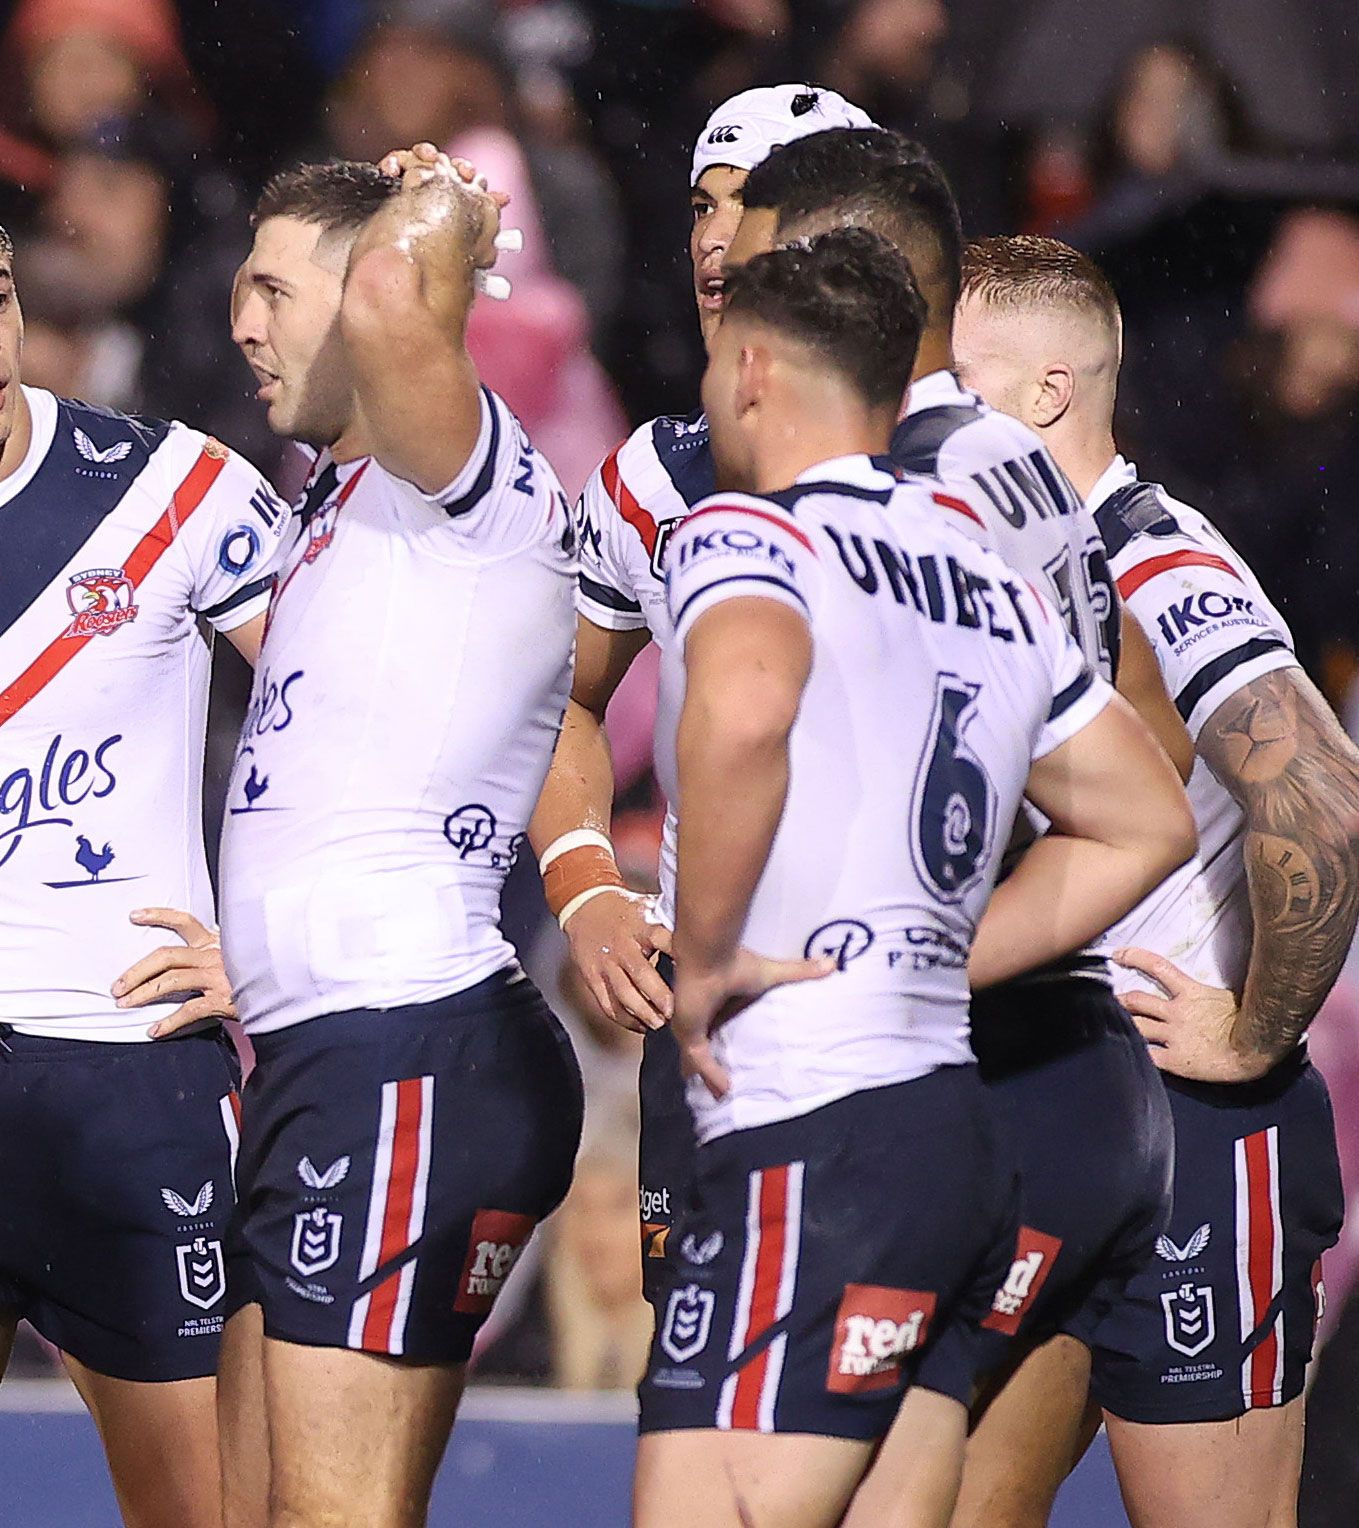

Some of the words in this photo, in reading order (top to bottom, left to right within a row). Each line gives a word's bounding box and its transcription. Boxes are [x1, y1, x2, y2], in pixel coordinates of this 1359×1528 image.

[971, 449, 1085, 531] UNI
[679, 529, 796, 577] IKON
[71, 569, 121, 583] SYDNEY
[1173, 623, 1220, 657] SERVICES
[912, 676, 995, 900] 6
[470, 1241, 520, 1277] re
[840, 1310, 925, 1359] red
[1161, 1369, 1223, 1383] PREMIERSHIP
